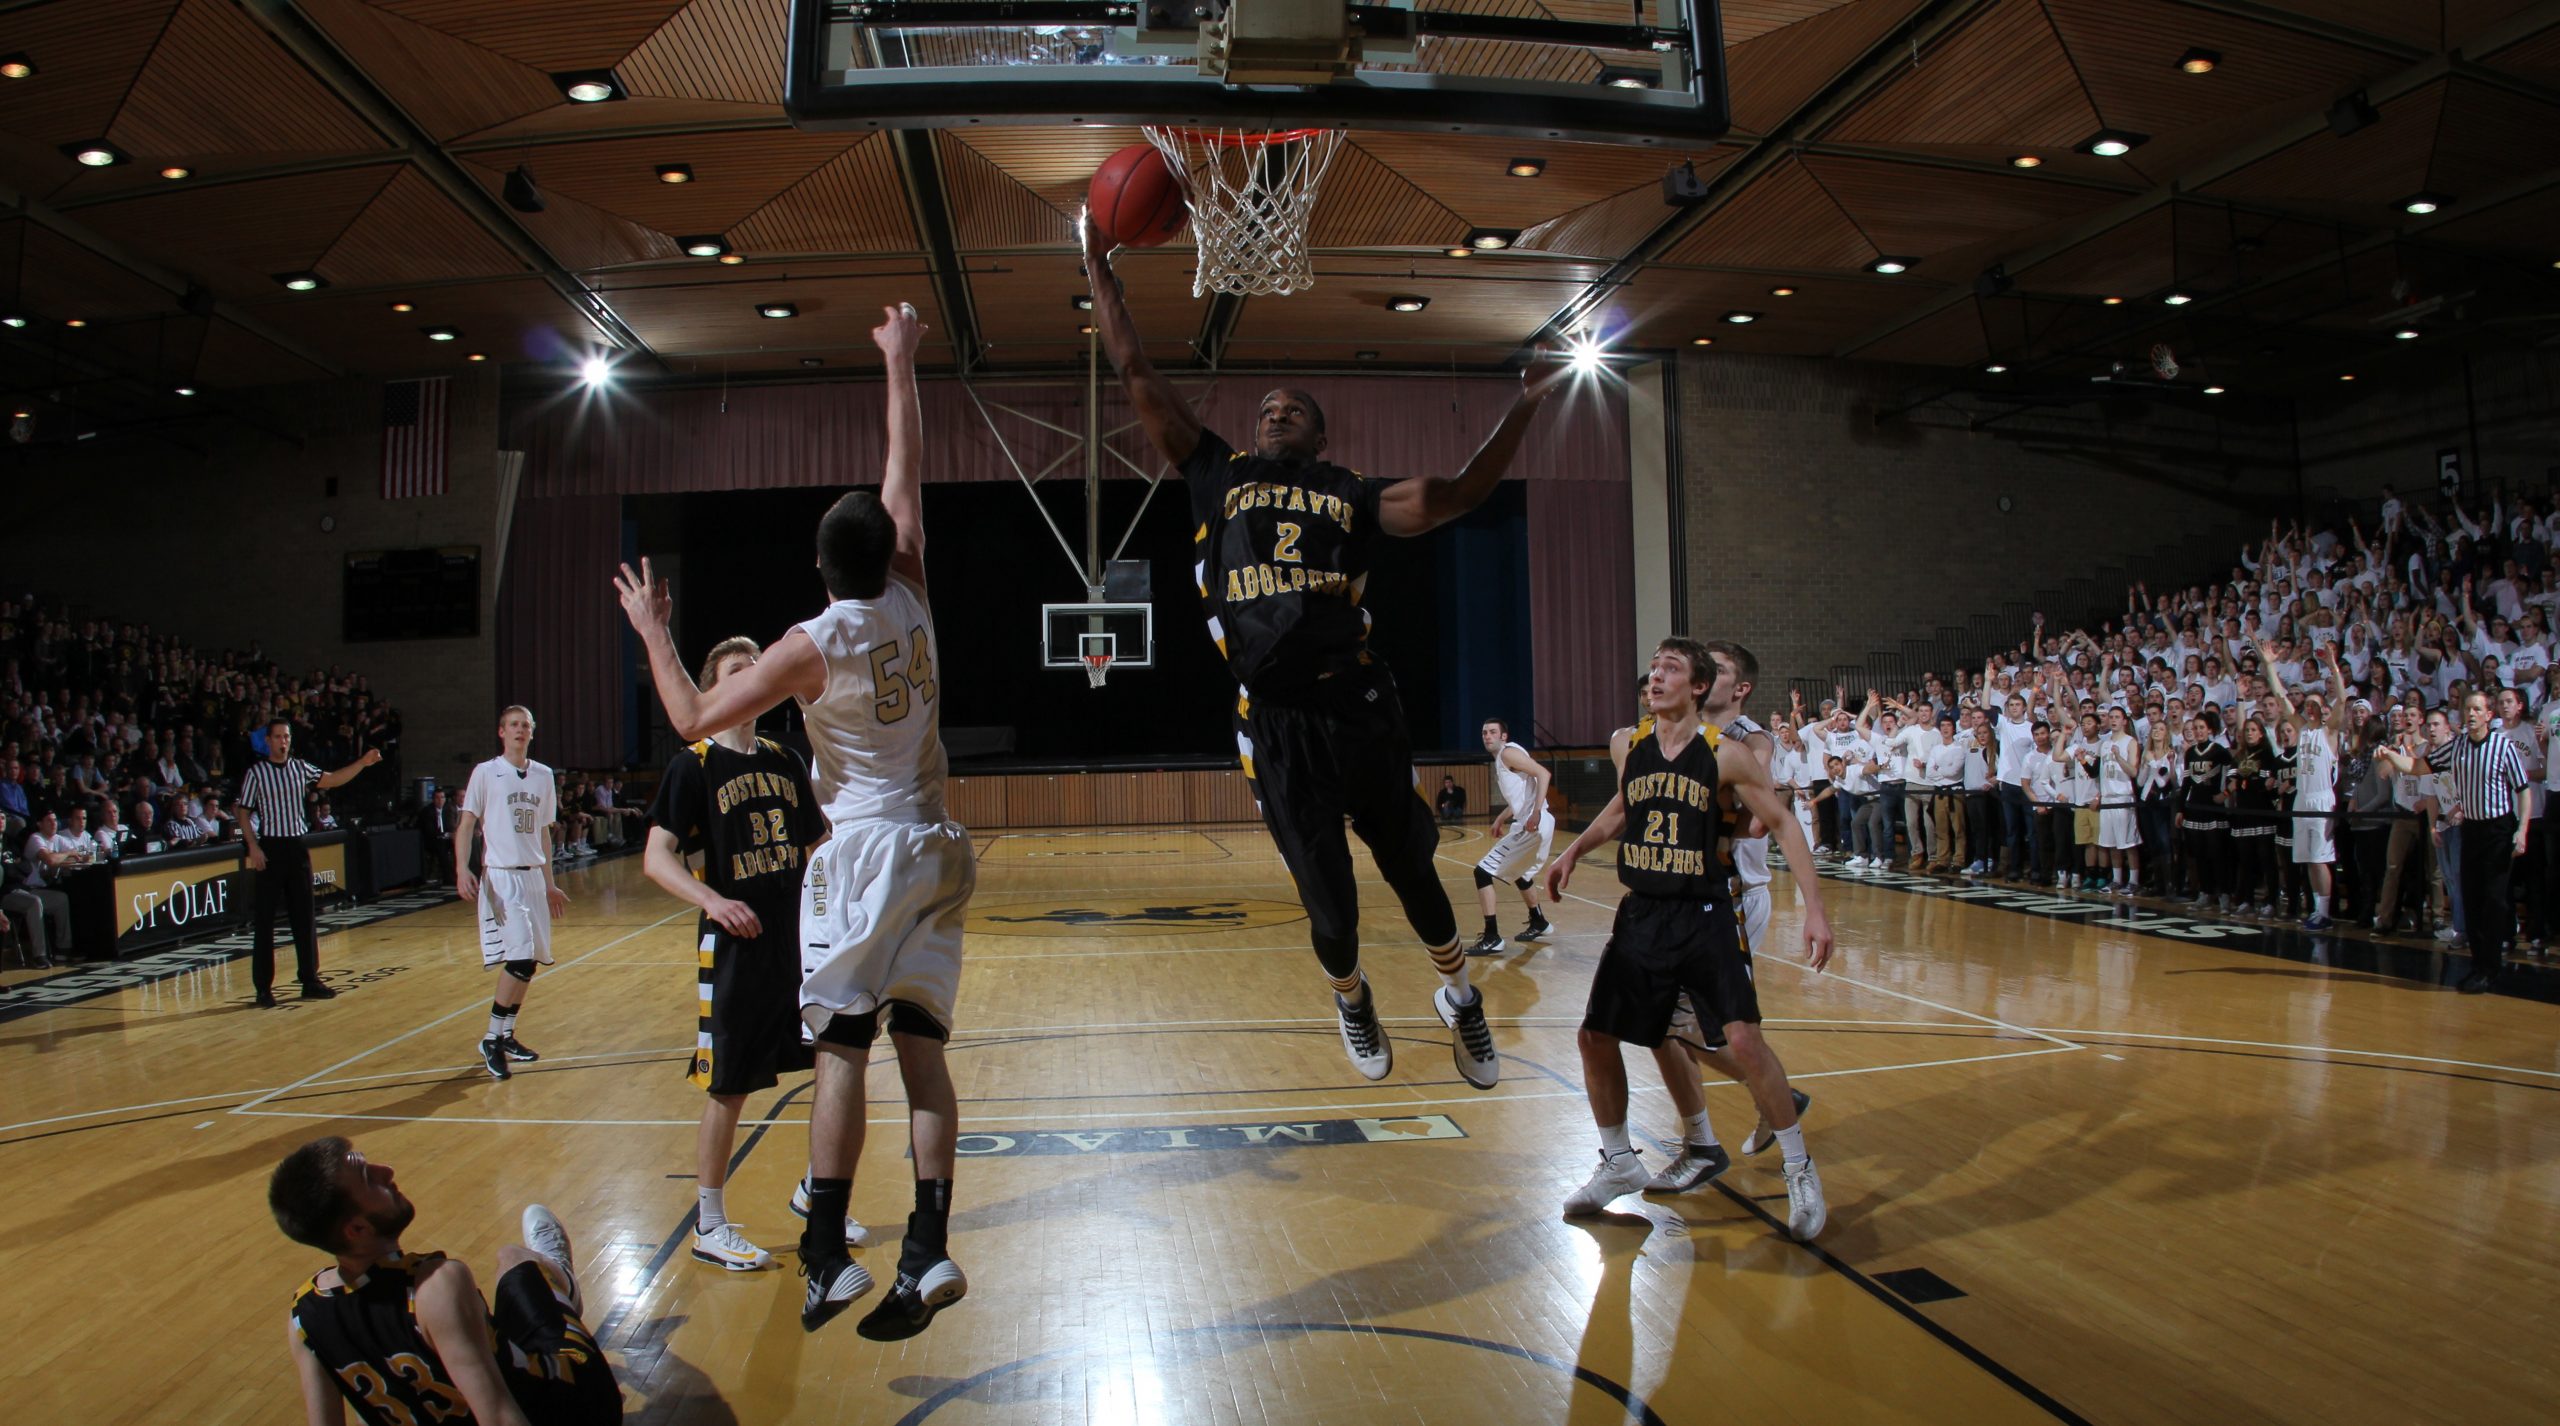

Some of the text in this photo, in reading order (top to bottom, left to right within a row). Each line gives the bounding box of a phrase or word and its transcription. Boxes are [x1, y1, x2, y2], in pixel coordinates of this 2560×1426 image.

[2440, 453, 2460, 497] 5
[1224, 482, 1354, 533] GUSTAVUS
[1274, 521, 1303, 563] 2
[868, 624, 936, 725] 54
[2510, 740, 2532, 757] OOPS
[716, 771, 799, 814] GUSTAVUS
[1627, 772, 1710, 812] GUSTAVUS
[514, 808, 535, 833] 30
[749, 808, 788, 845] 32
[1643, 810, 1679, 845] 21
[313, 869, 337, 885] ENTER
[1623, 842, 1705, 876] ADOLPHUS
[1903, 886, 2115, 915] OLAF
[2092, 912, 2263, 939] ST.
[334, 1352, 470, 1426] 33
